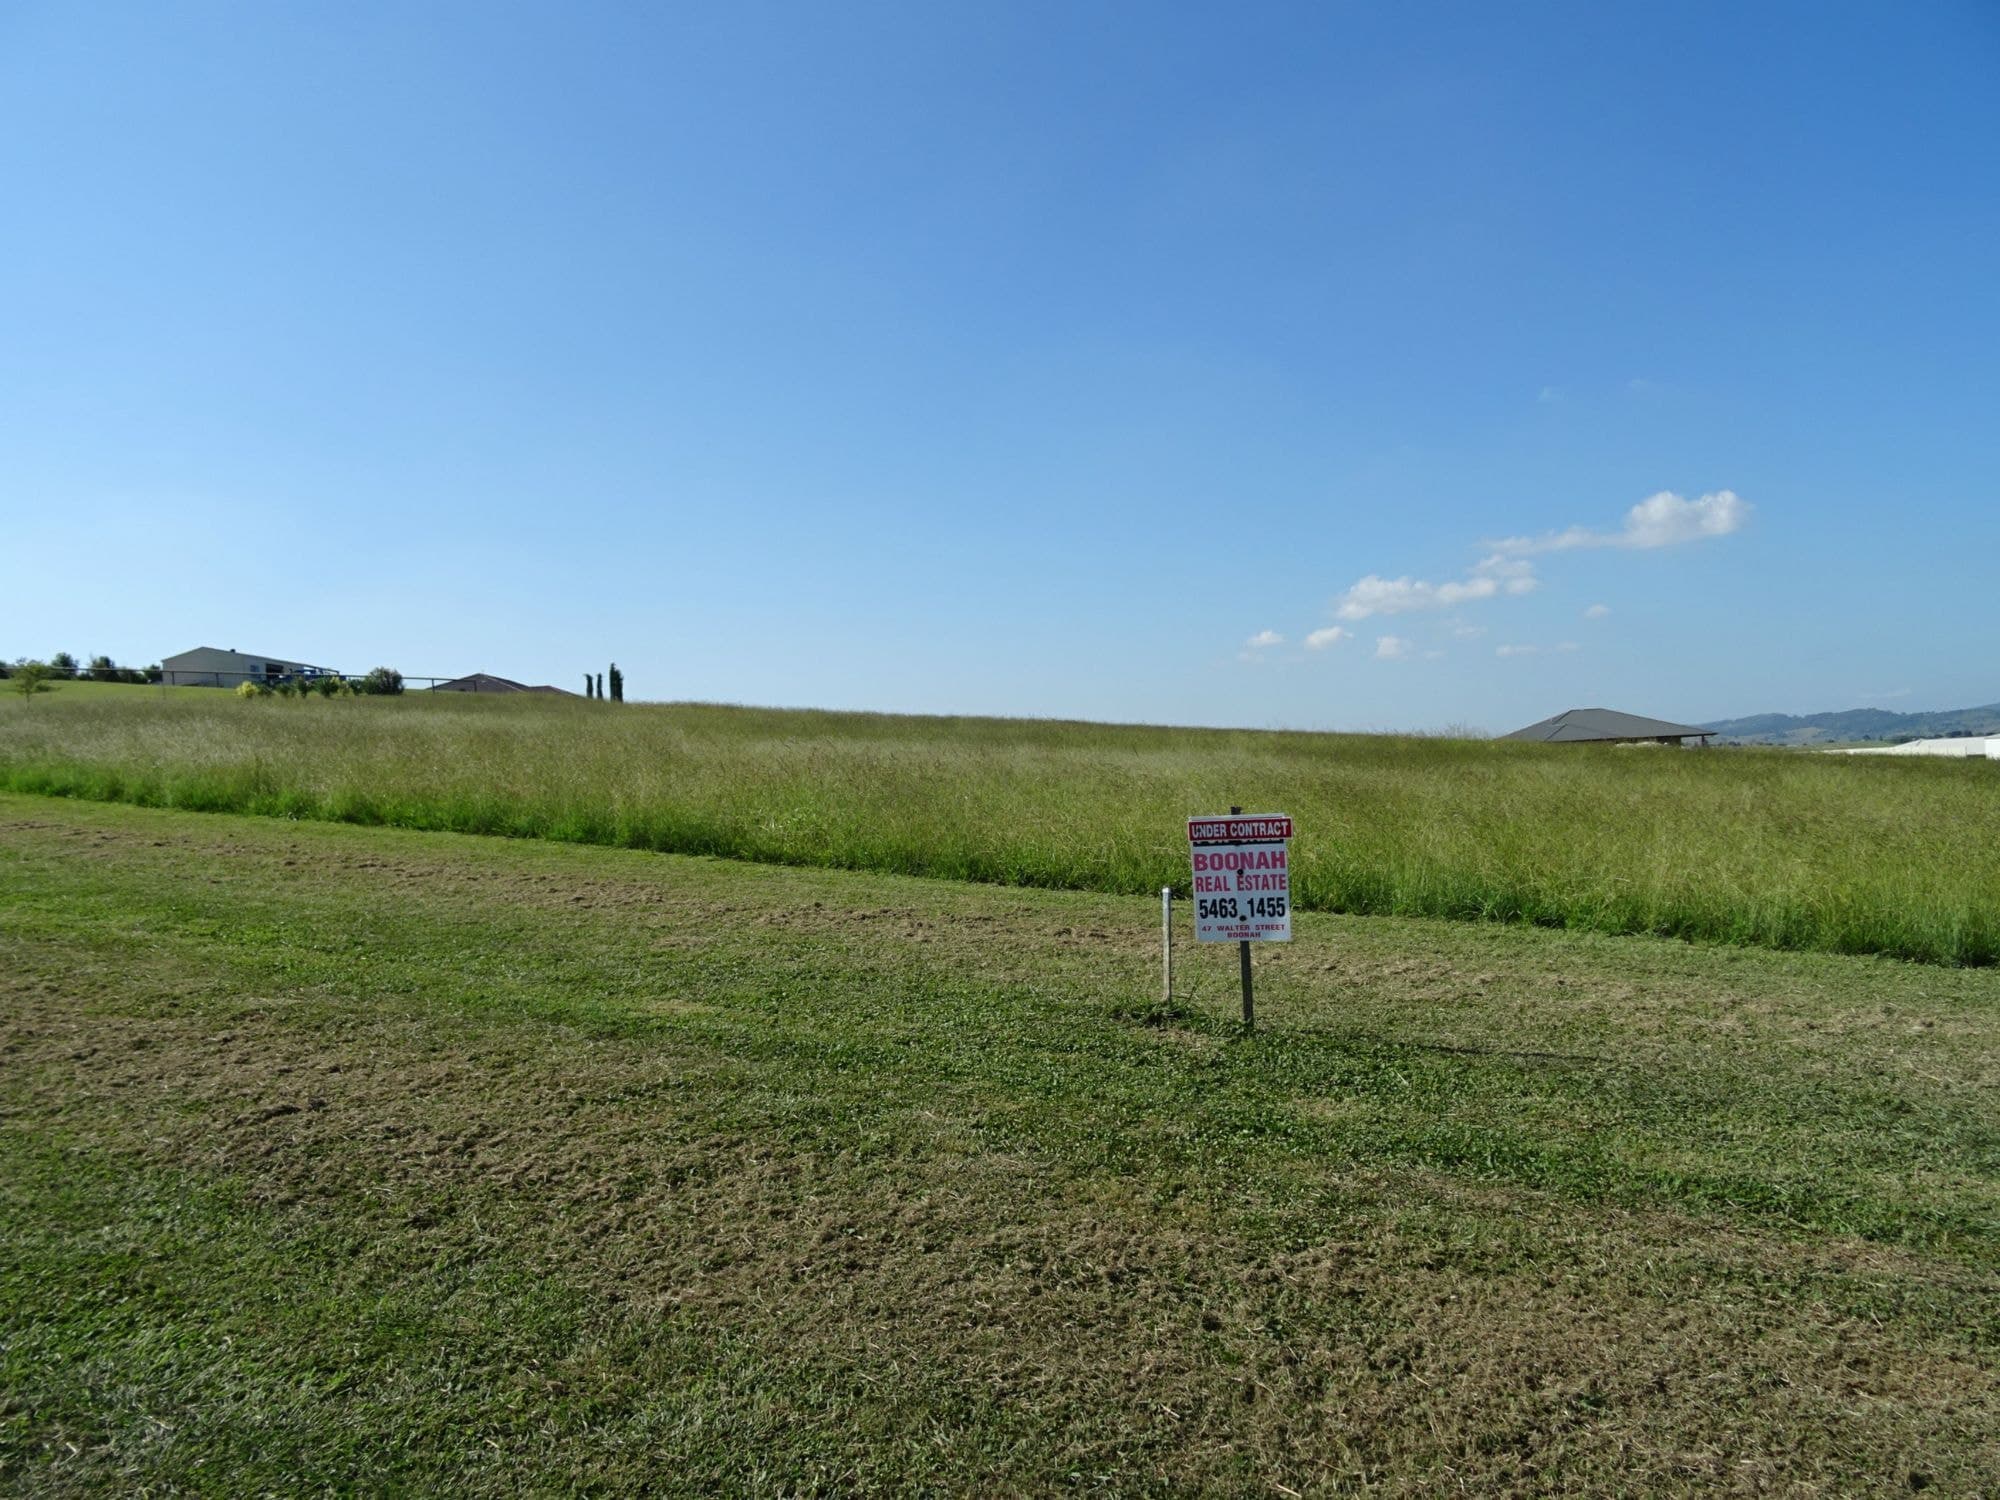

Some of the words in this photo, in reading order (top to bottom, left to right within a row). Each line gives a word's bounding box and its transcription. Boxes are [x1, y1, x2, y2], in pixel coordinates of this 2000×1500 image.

[1191, 823, 1227, 838] UNDER
[1229, 821, 1288, 836] CONTRACT
[1193, 851, 1286, 872] BOONAH
[1195, 875, 1230, 892] REAL
[1237, 874, 1287, 891] ESTATE
[1199, 898, 1238, 919] 5463
[1247, 897, 1285, 917] 1455
